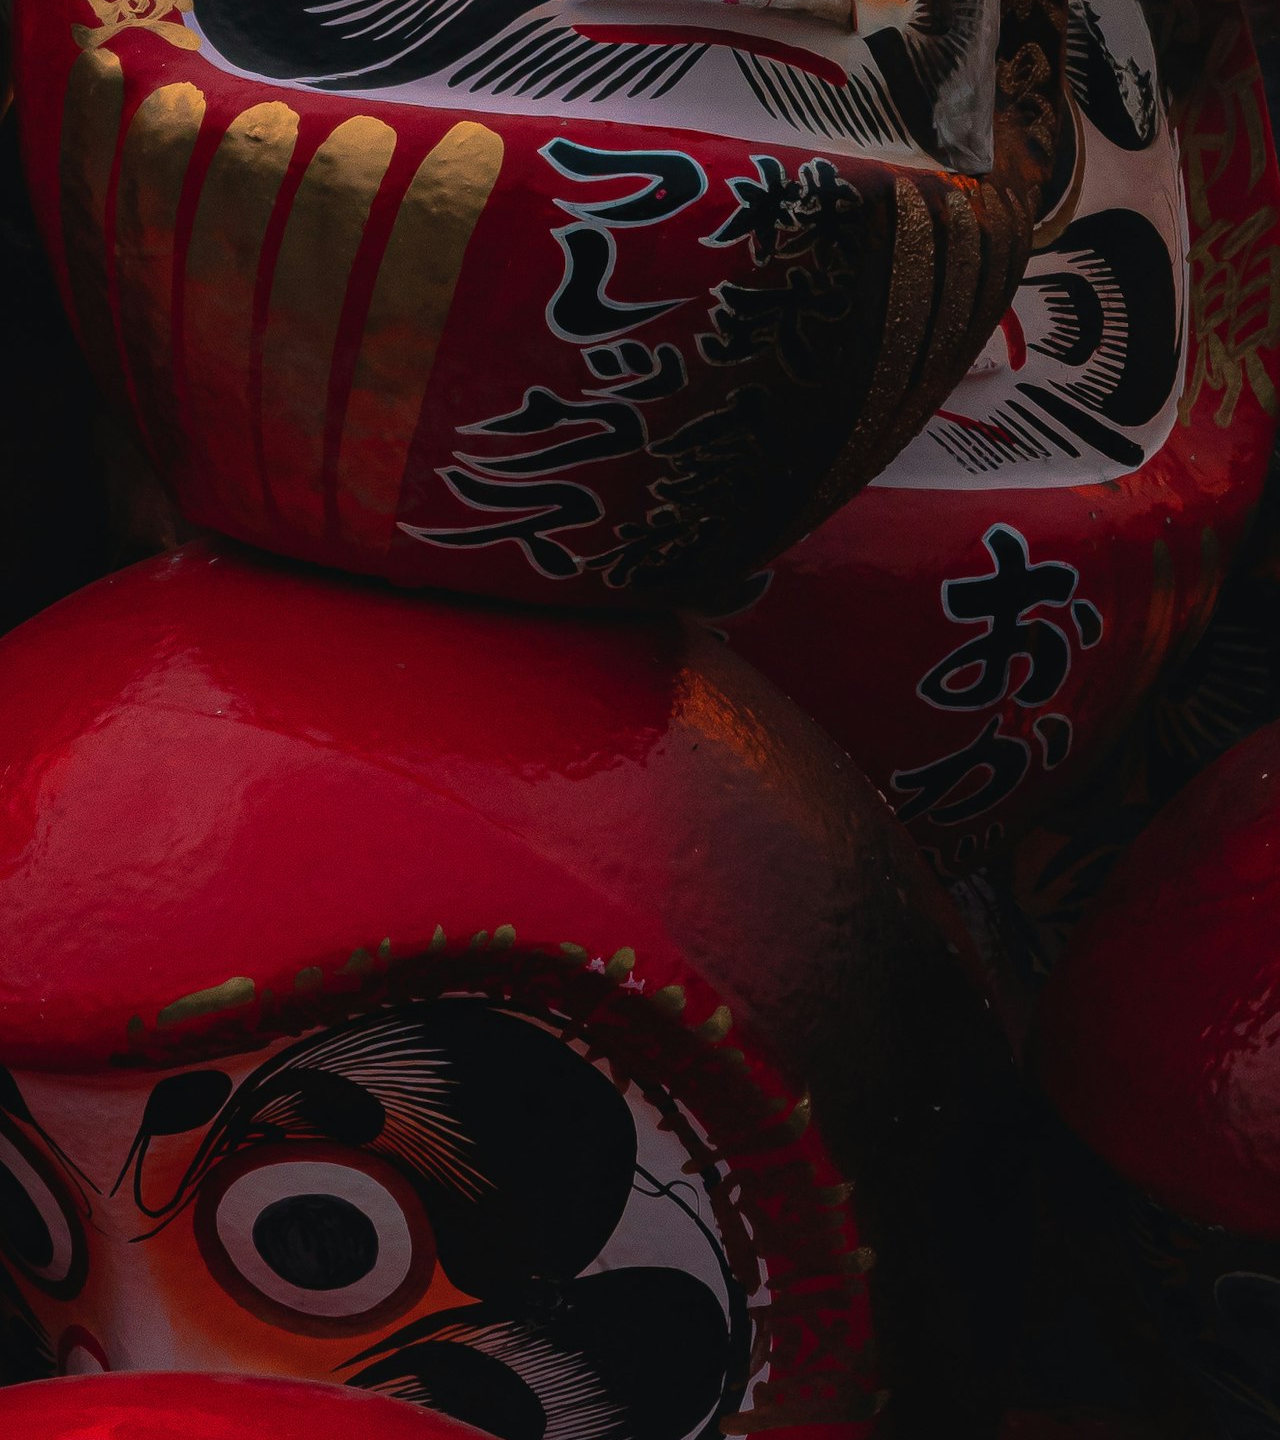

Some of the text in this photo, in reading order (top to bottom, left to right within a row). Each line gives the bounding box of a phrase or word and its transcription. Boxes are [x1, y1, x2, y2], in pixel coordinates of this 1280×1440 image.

[396, 137, 708, 580] フレックス
